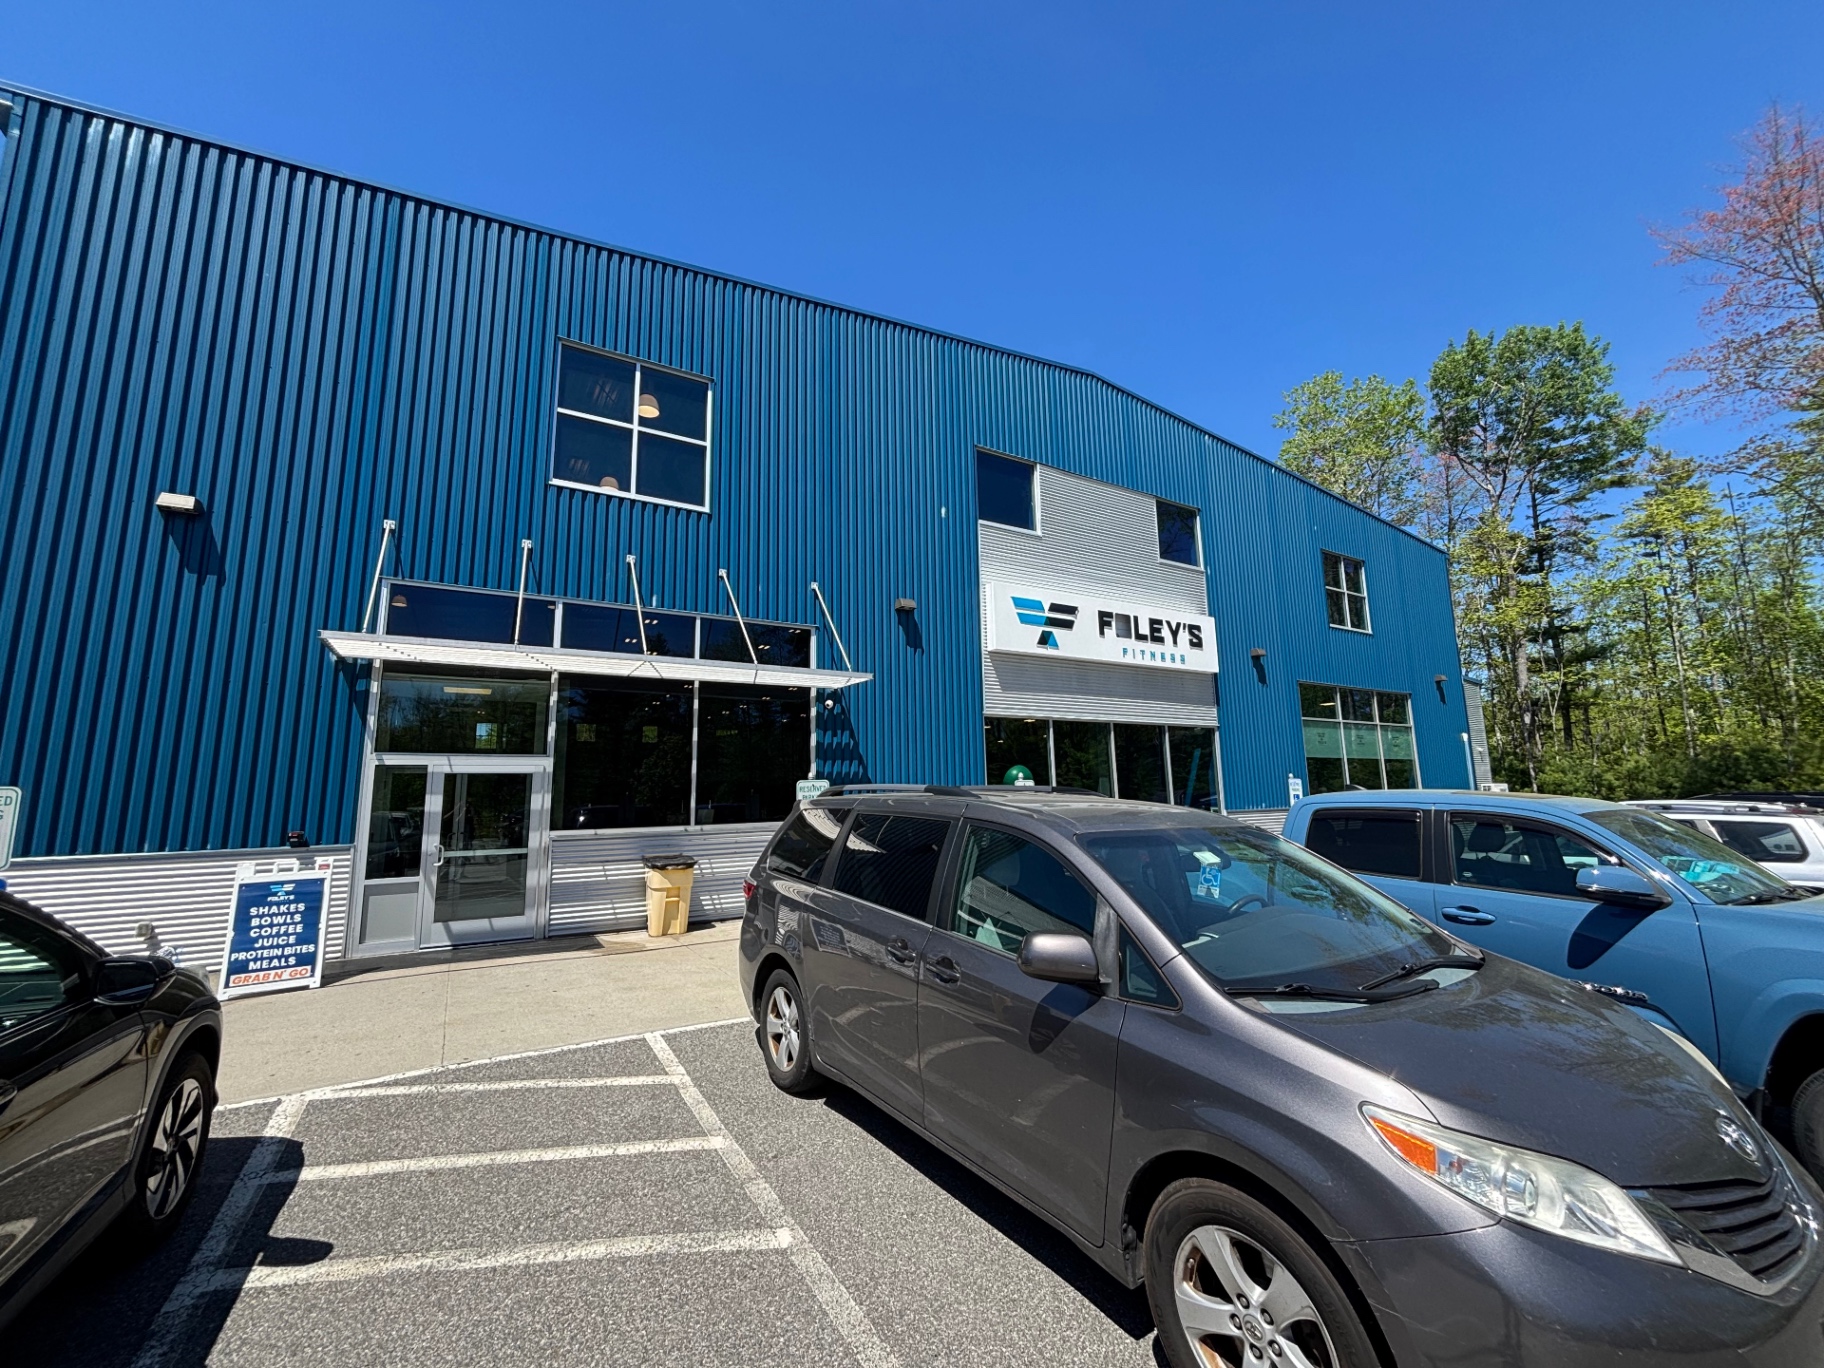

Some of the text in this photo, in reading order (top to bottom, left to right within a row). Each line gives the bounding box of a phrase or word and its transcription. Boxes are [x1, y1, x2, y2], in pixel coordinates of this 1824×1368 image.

[1122, 648, 1186, 665] FITNESS
[250, 903, 305, 915] SHAKES
[251, 914, 301, 926] BOWLS
[250, 924, 303, 937] COFFEE
[254, 935, 296, 947] JUICE
[231, 944, 315, 961] PROTEIN BITES
[248, 957, 296, 970] MEALS
[232, 972, 271, 985] GRAB
[289, 968, 309, 977] GO
